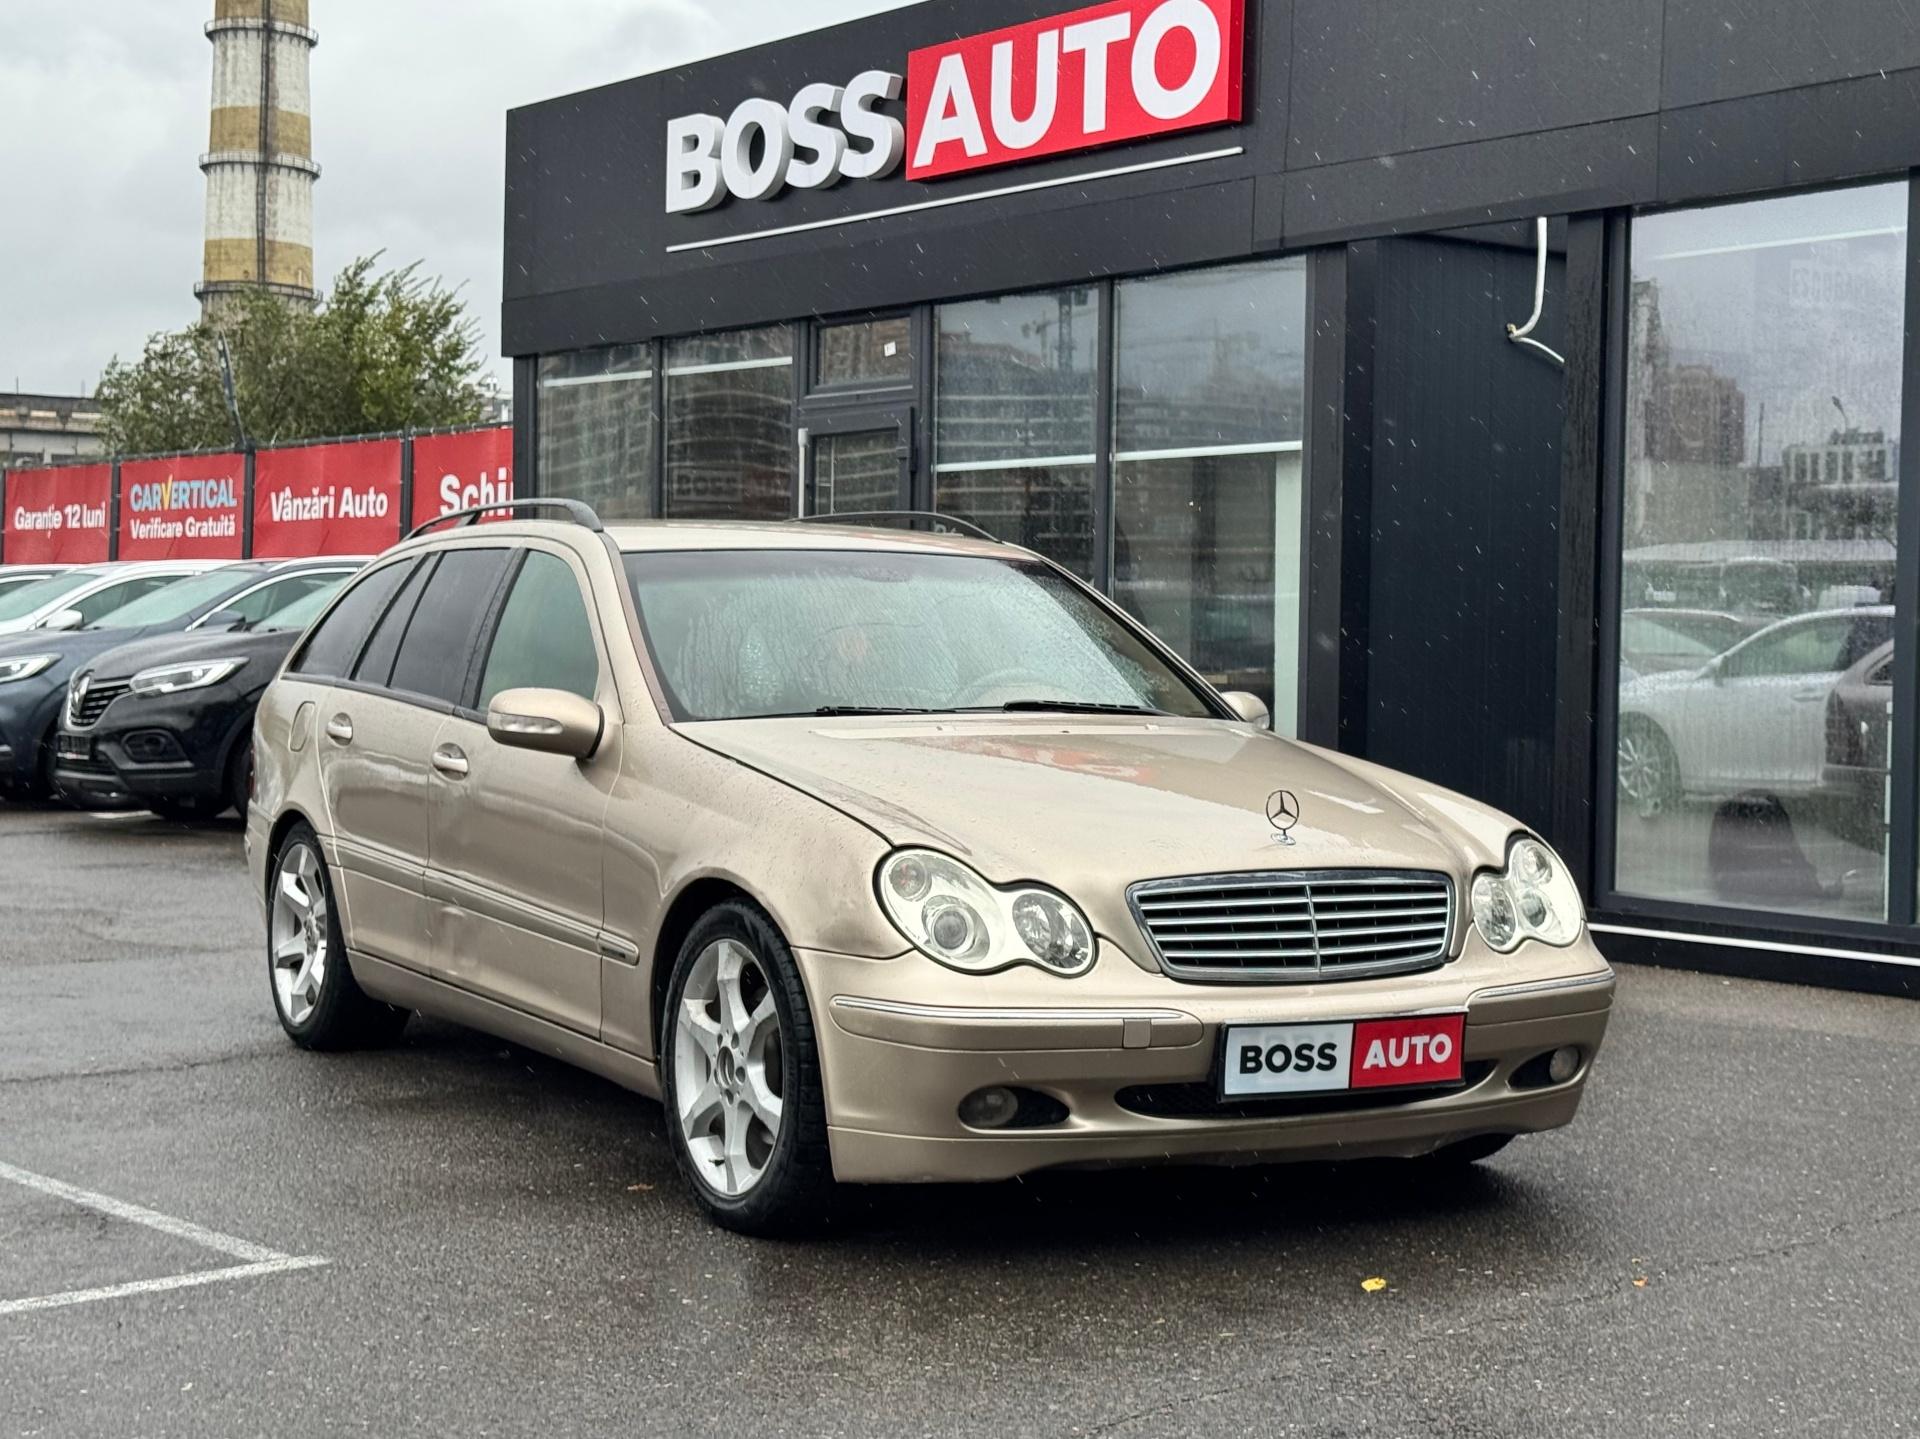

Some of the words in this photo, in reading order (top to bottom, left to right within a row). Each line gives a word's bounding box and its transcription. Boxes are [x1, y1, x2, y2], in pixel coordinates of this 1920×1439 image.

[666, 69, 905, 213] BOSS
[913, 0, 1221, 168] AUTO
[130, 474, 238, 512] CARVERTICAL
[270, 485, 336, 522] Vânzări
[338, 486, 388, 519] Auto
[440, 467, 514, 517] Schi
[64, 503, 81, 529] 12
[82, 501, 106, 528] luni
[130, 517, 183, 539] Verificare
[185, 513, 236, 538] Gratuită
[1239, 1042, 1338, 1074] BOSS
[1362, 1033, 1453, 1069] AUTO
